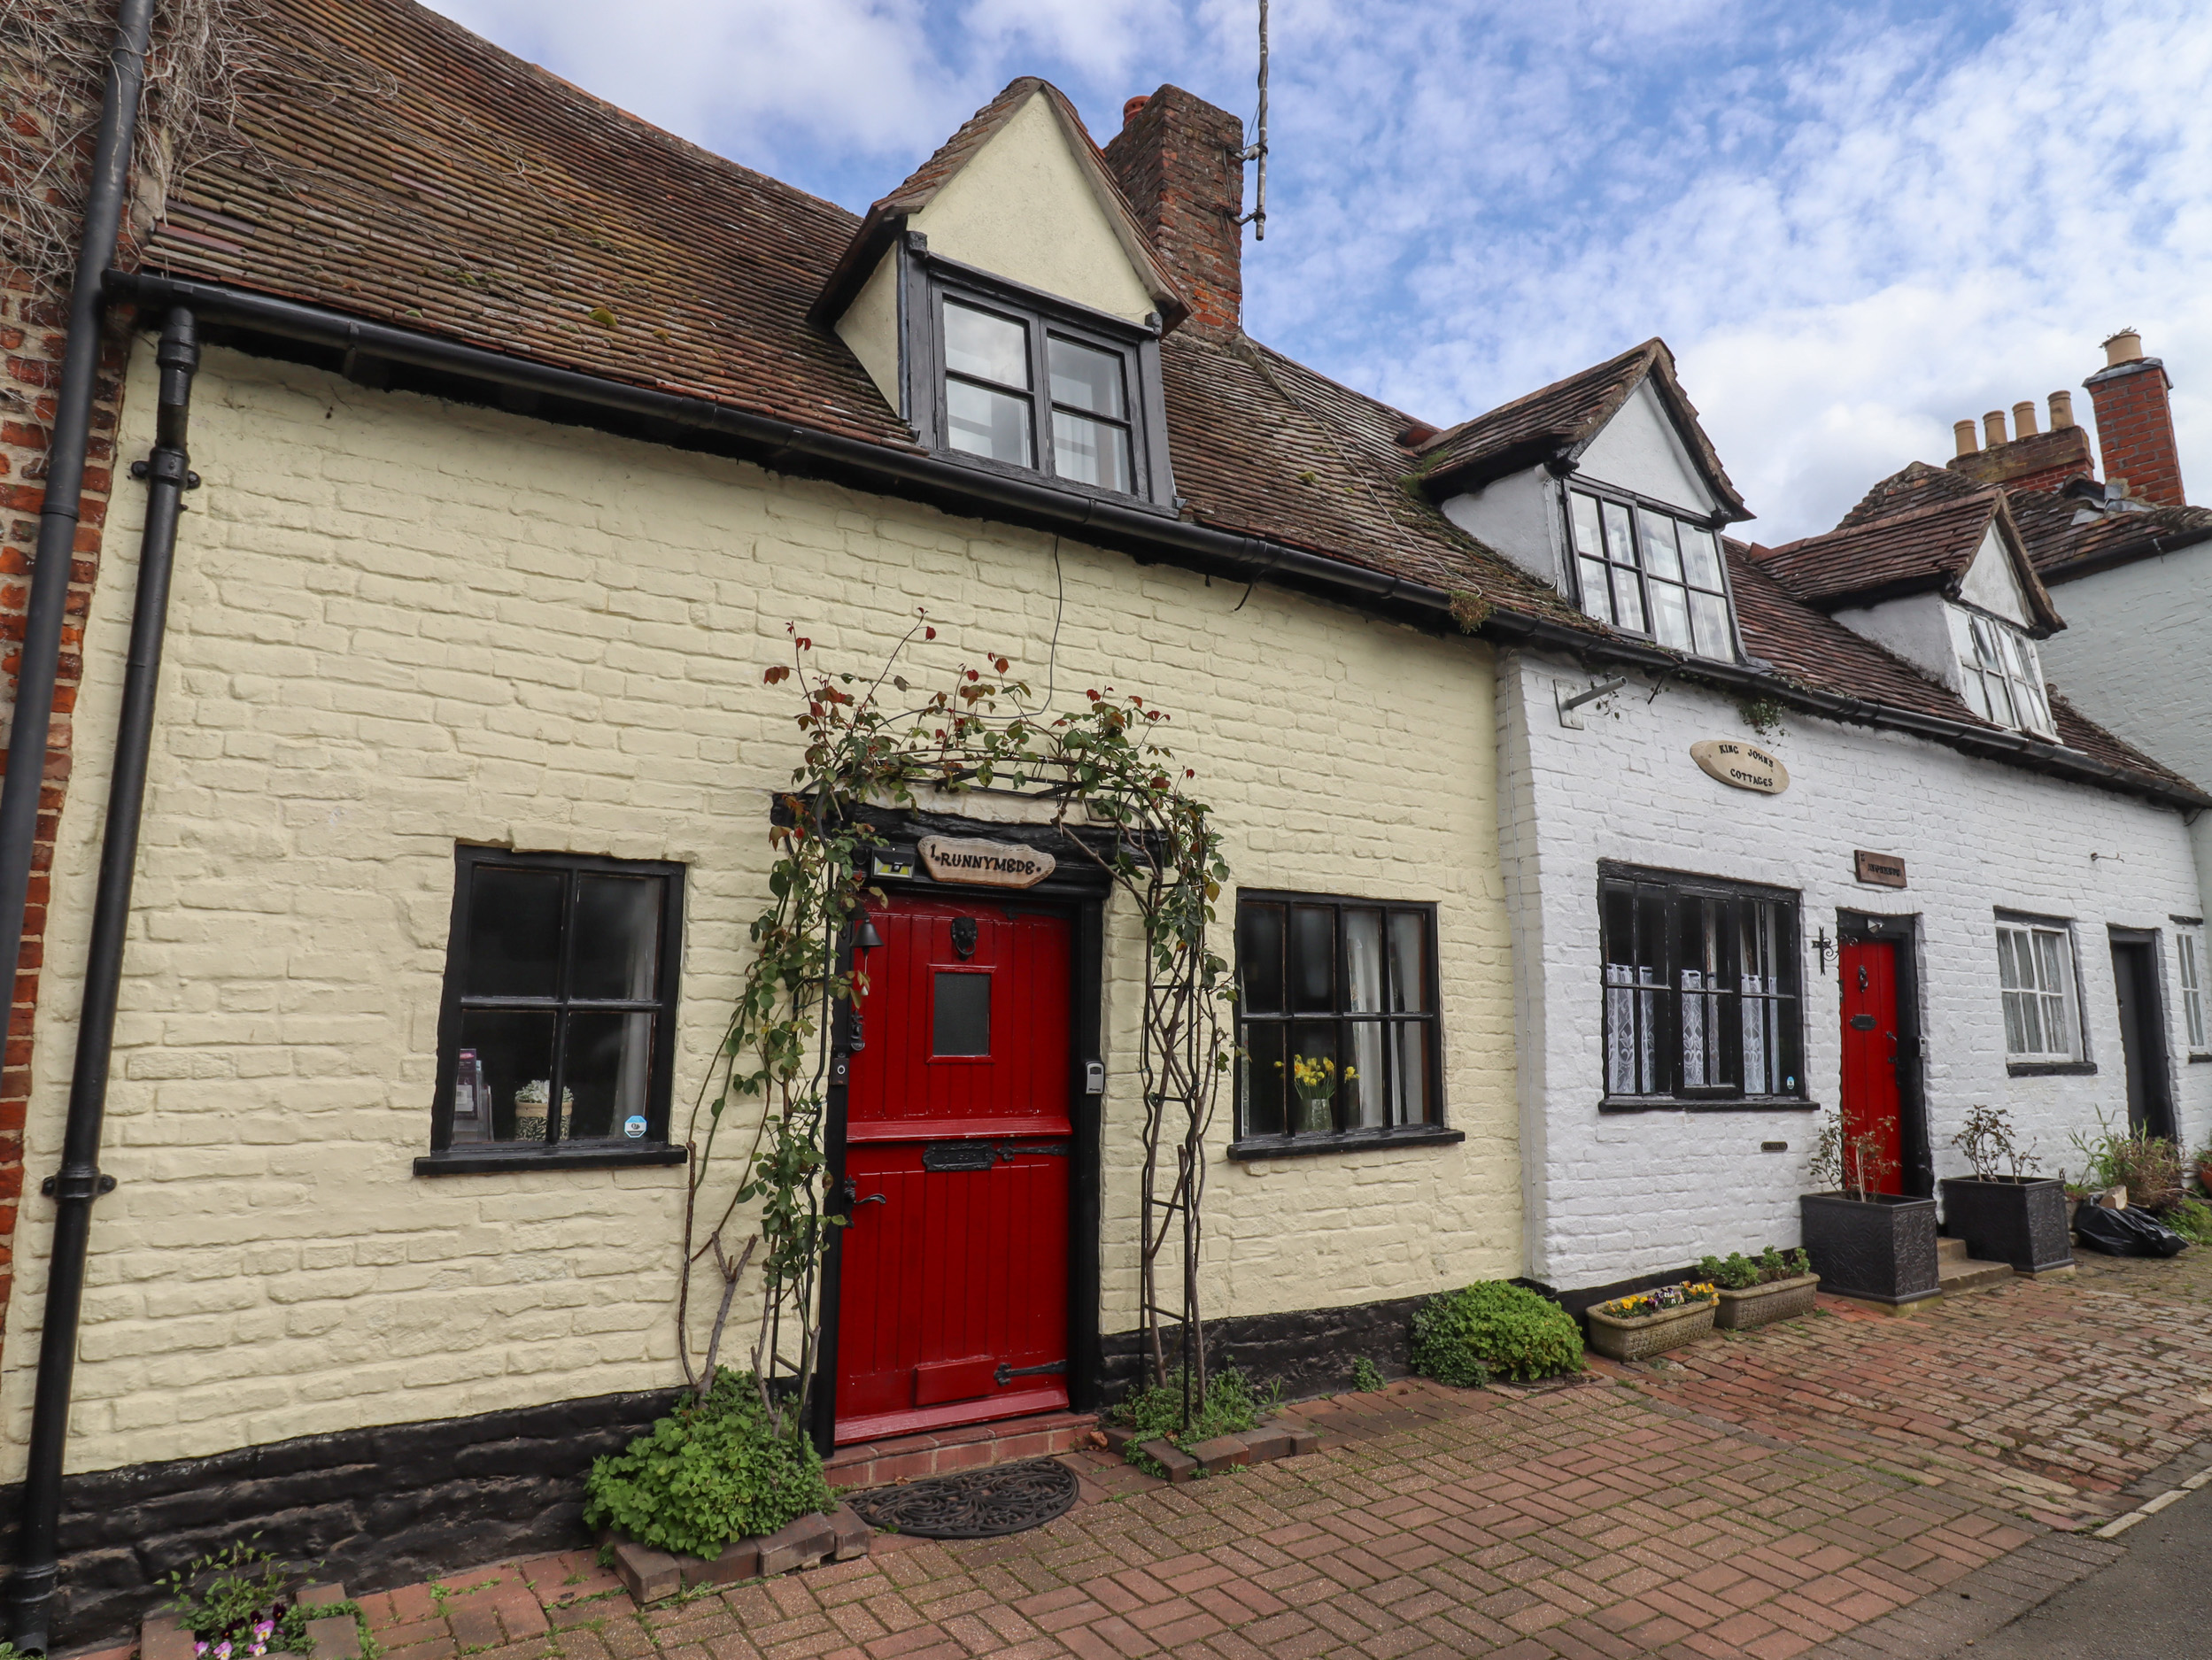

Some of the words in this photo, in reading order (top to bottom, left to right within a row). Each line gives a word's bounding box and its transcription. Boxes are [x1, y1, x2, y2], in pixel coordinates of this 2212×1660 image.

[1719, 745, 1739, 754] KING
[1748, 749, 1773, 768] JOHN'S
[1730, 768, 1773, 786] COTTAGES
